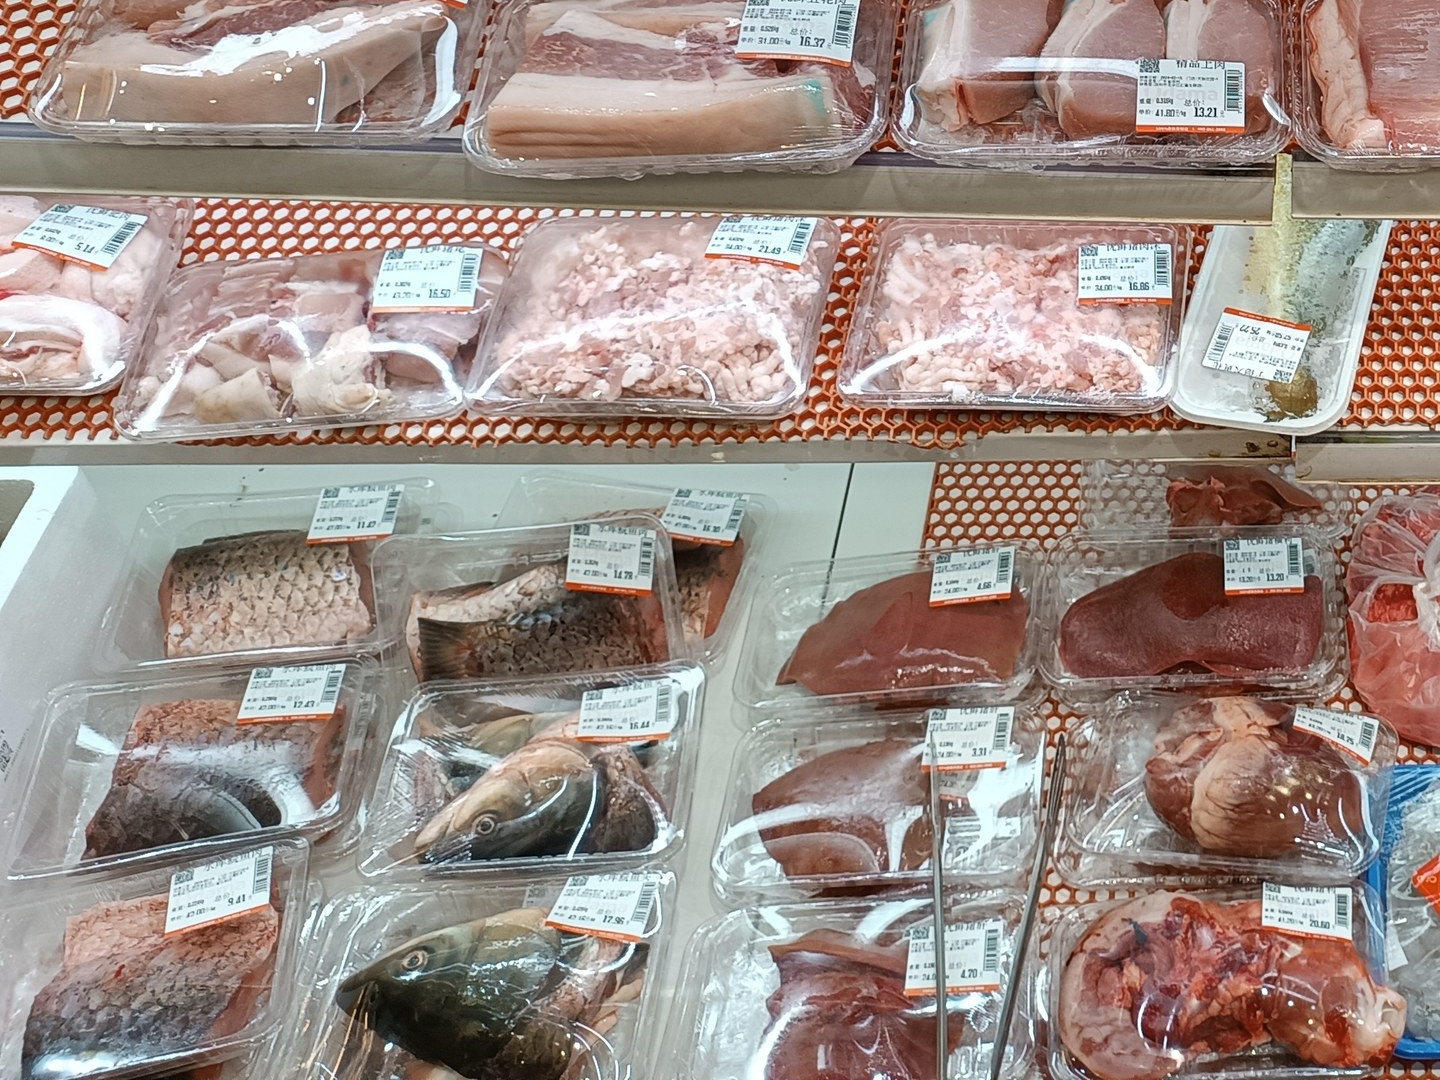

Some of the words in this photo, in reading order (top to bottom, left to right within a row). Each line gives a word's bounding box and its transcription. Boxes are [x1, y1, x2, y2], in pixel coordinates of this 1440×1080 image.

[800, 36, 826, 48] 16.37
[1194, 108, 1218, 117] 13.21
[75, 242, 95, 253] 5.14
[759, 246, 782, 254] 21.49
[1129, 282, 1149, 290] 16.86
[429, 289, 450, 298] 16.50
[1266, 573, 1284, 581] 13.20
[972, 748, 987, 756] 3.31
